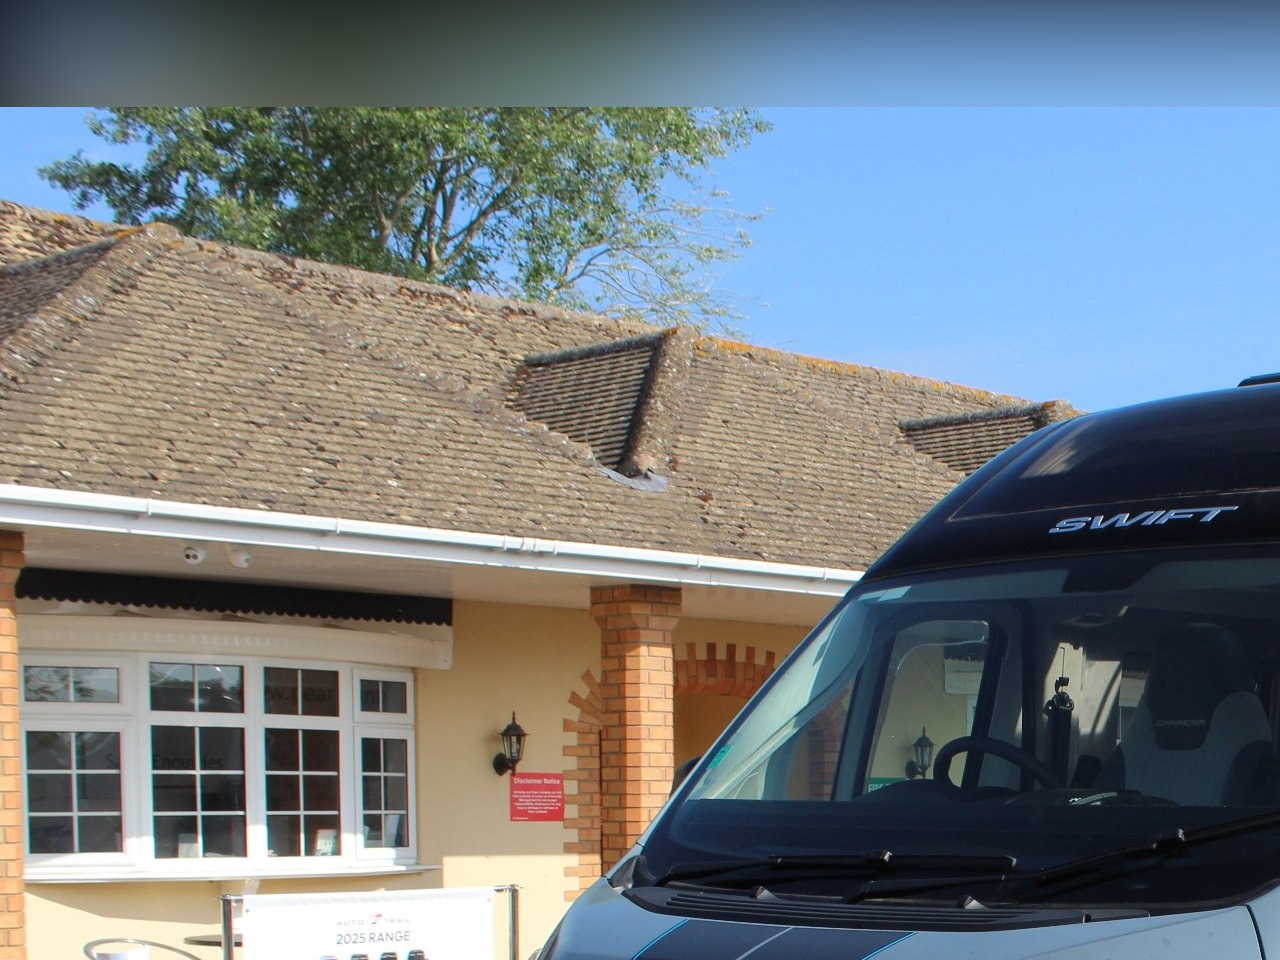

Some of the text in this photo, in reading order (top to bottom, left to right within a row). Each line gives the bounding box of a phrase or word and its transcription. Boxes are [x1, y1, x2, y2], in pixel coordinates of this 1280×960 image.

[1048, 505, 1239, 534] SWIFT
[336, 930, 411, 945] 2025 RANGE
